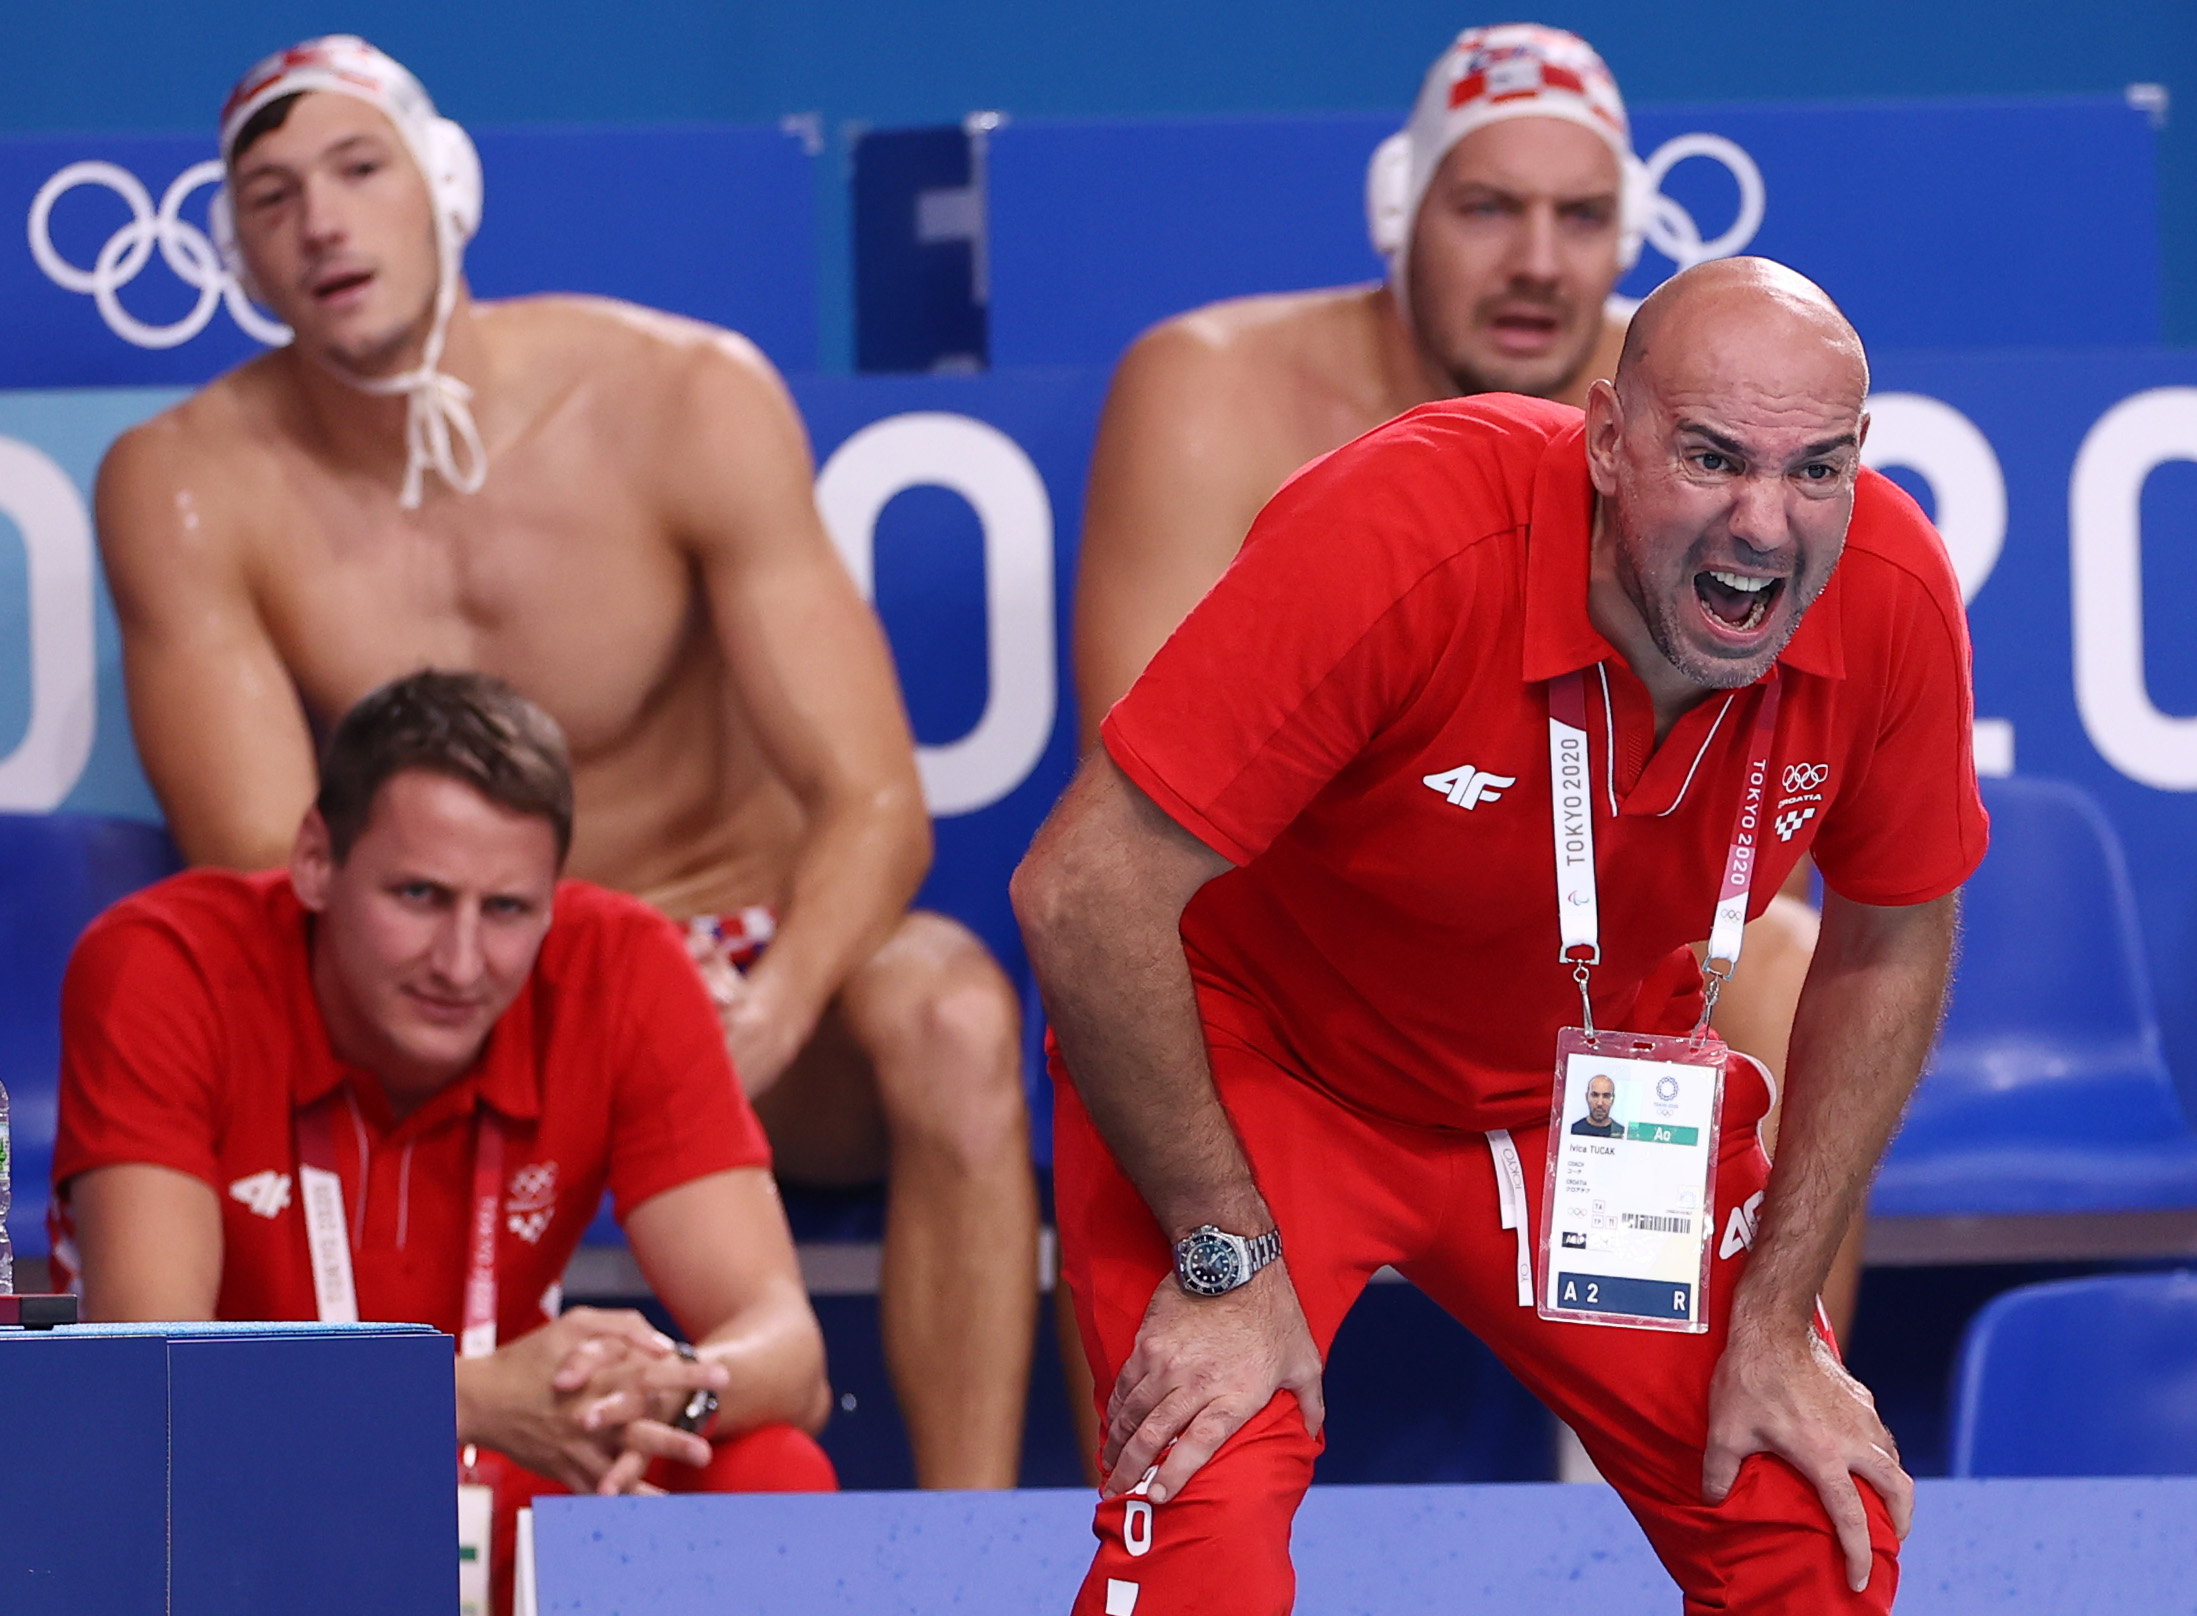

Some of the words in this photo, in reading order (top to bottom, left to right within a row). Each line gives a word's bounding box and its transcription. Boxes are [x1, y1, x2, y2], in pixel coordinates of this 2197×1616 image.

[1423, 764, 1517, 811] 4F
[1560, 738, 1582, 790] 2020
[1741, 758, 1767, 829] TOKYO
[1562, 796, 1586, 867] TOKYO
[1730, 832, 1753, 886] 2020
[1569, 1144, 1587, 1153] Ivica
[1590, 1145, 1616, 1156] TUCAK
[1563, 1280, 1577, 1301] A
[1586, 1282, 1599, 1304] 2
[1673, 1290, 1686, 1311] R
